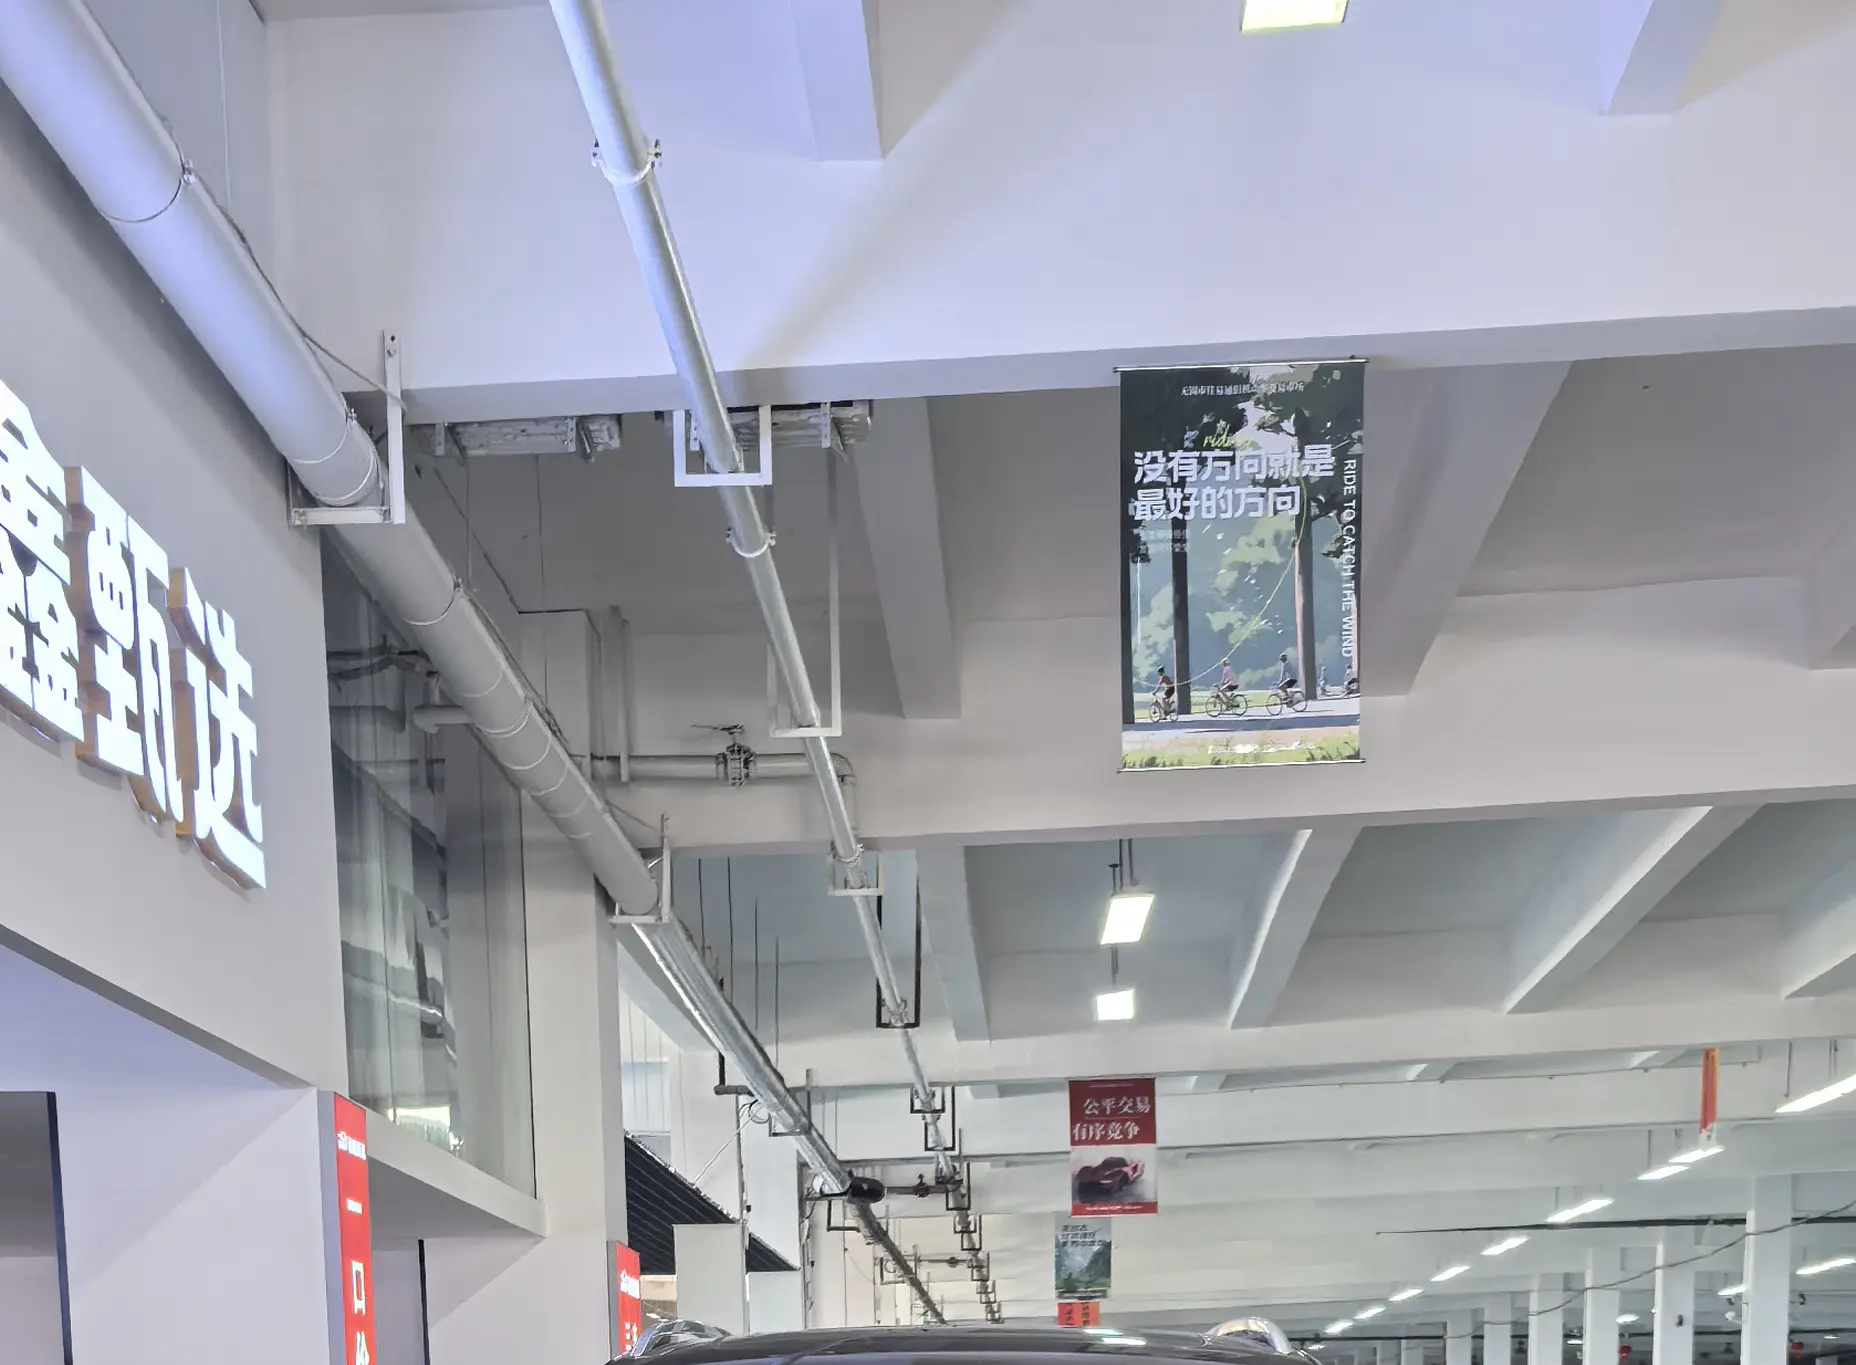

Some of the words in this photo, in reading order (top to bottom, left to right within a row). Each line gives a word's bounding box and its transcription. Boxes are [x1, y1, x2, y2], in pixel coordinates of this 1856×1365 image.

[1134, 444, 1335, 483] 没有方向就是
[1344, 459, 1357, 496] RIDE
[1132, 485, 1300, 520] 最好的方向
[1343, 500, 1356, 522] TO
[1343, 525, 1356, 575] CATCH
[1342, 579, 1355, 611] THE
[1341, 614, 1354, 657] WIND
[1083, 1096, 1151, 1115] 公平交易
[1072, 1120, 1140, 1141] 有序竞争
